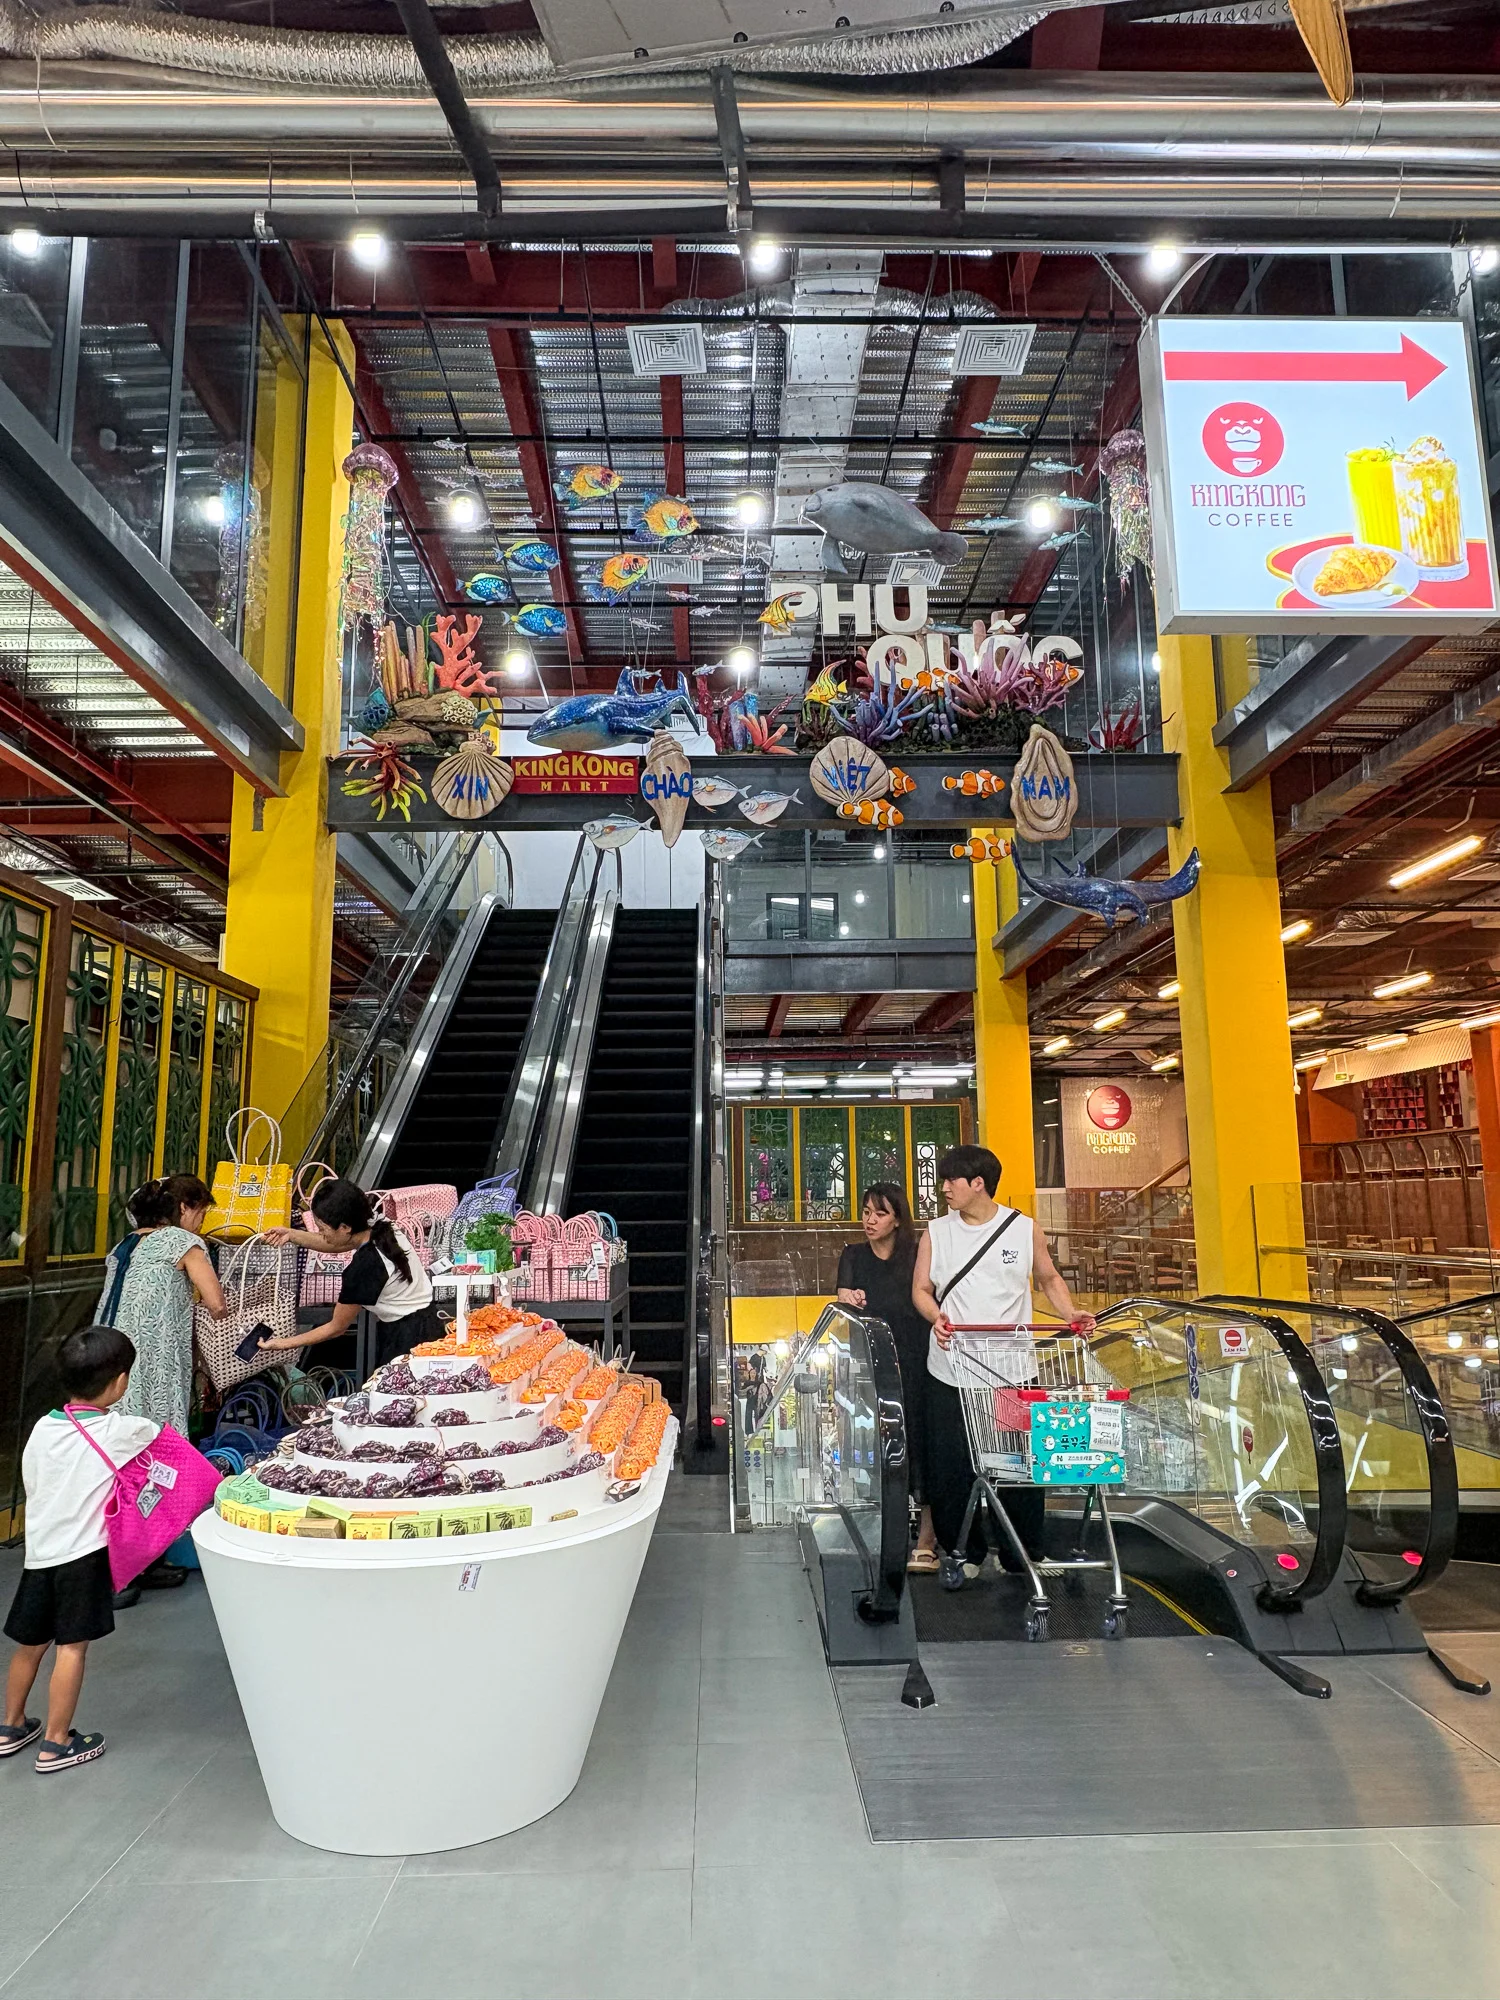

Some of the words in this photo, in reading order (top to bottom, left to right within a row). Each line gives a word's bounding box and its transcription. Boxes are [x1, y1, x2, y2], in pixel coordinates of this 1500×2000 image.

[1190, 484, 1306, 507] KINGKONG
[1208, 513, 1293, 527] COFFEE
[515, 756, 634, 777] KINGKONG
[822, 757, 871, 796] VIỆT
[452, 773, 489, 801] XIN
[641, 765, 694, 800] CHÀO
[1021, 771, 1070, 801] NAM
